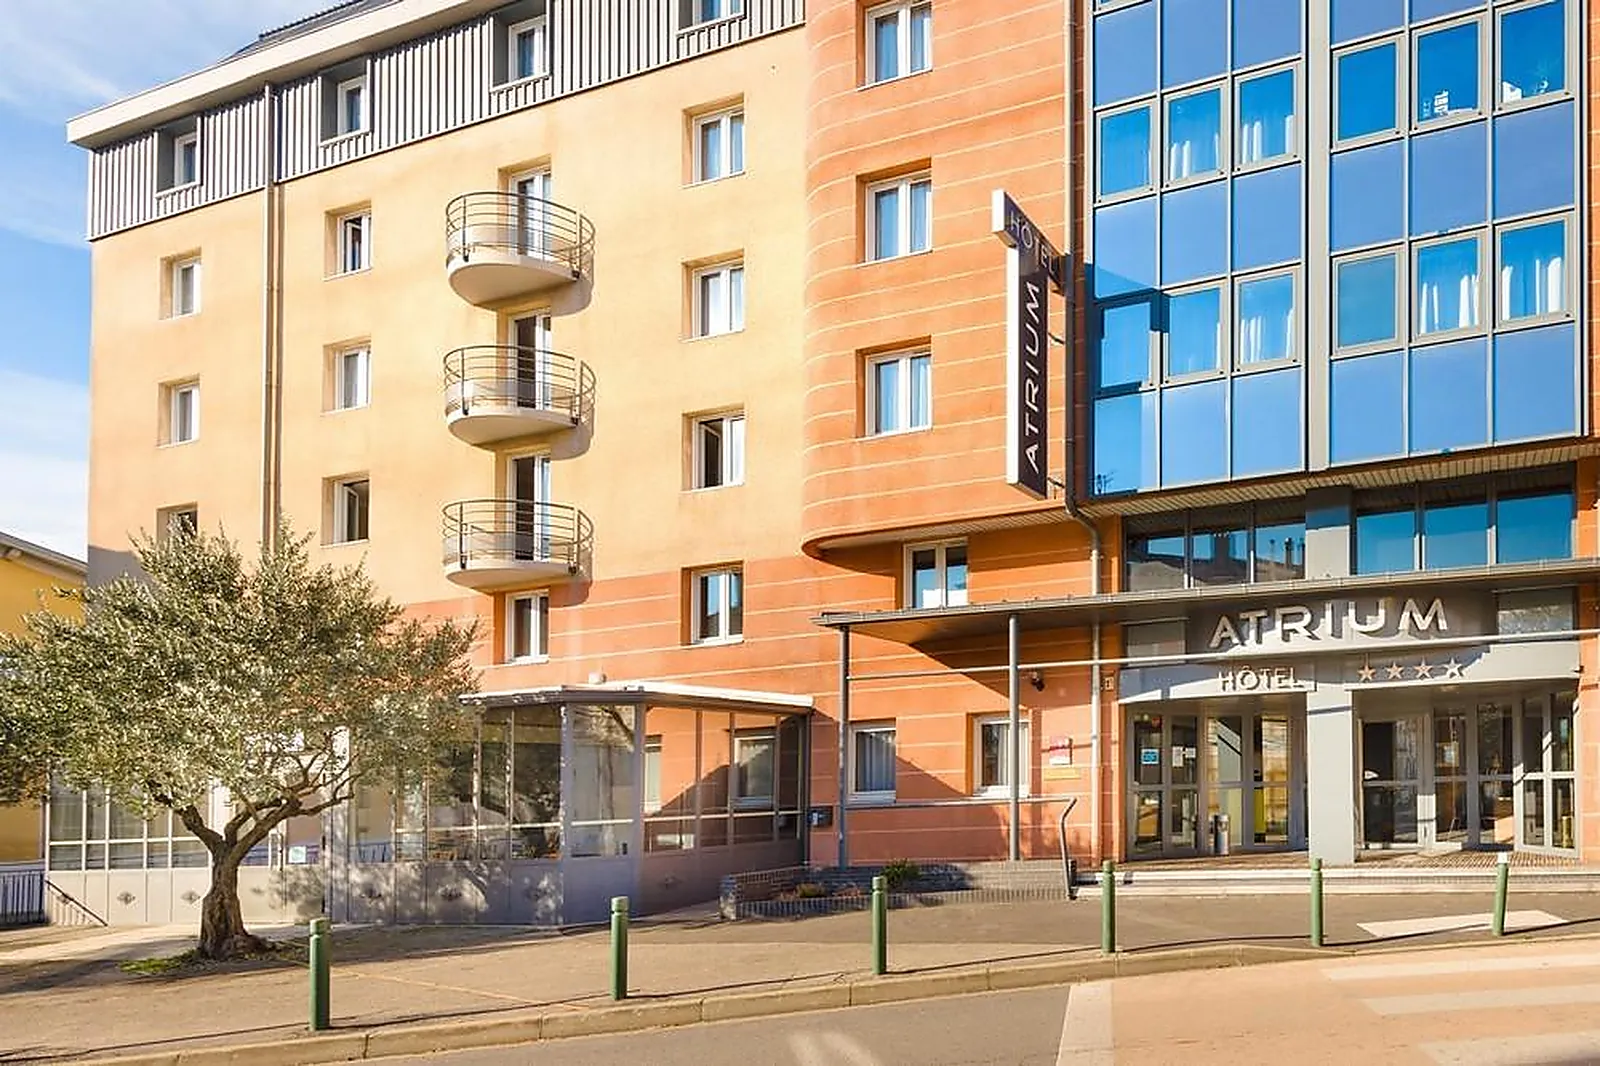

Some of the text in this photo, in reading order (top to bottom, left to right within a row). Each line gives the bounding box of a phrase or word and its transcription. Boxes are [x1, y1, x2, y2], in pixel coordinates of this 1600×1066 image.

[1025, 281, 1040, 475] ATRIUM
[1209, 597, 1448, 649] ATRIUM
[1217, 664, 1305, 692] HÔTEL
